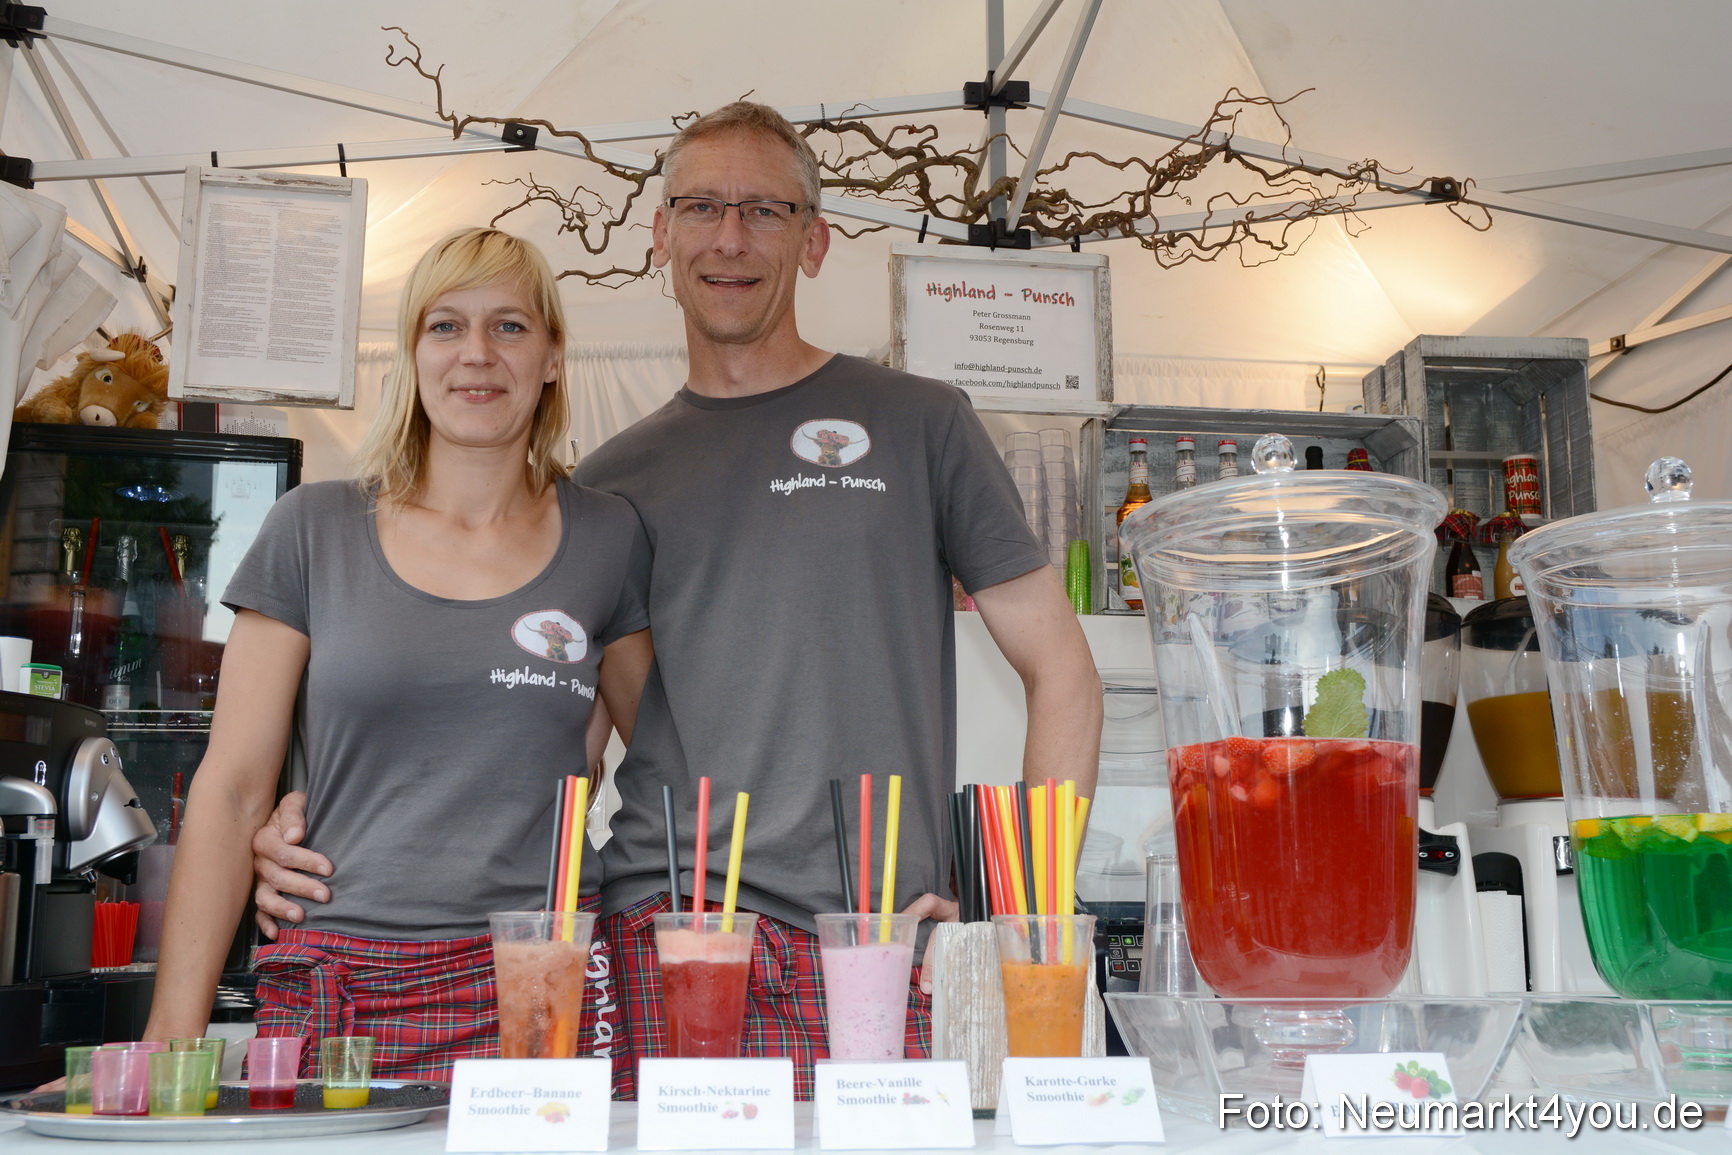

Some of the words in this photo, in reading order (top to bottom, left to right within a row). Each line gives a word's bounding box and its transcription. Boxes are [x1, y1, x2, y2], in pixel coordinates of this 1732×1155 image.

[925, 280, 996, 303] Highland
[1021, 287, 1075, 307] Punsch
[972, 310, 991, 318] Peter
[992, 311, 1031, 321] Grossmann
[979, 322, 1014, 333] Rosenweg
[1016, 325, 1025, 333] 11
[969, 334, 992, 343] 93053
[993, 336, 1034, 347] Regensburg
[954, 362, 1043, 374] info@highland-punsch.de
[943, 378, 1061, 390] w.facebook.com/highlandpunsch
[769, 472, 826, 496] Highland
[840, 475, 886, 492] Punsch
[1508, 489, 1539, 502] Punsc
[109, 658, 143, 680] umm
[489, 665, 556, 690] Highland
[836, 1077, 923, 1090] Beere-Vanille
[1024, 1075, 1118, 1088] Karotte-Gurke
[657, 1084, 771, 1098] Kirsch-Nektarine
[1026, 1090, 1086, 1103] Smoothie
[836, 1093, 897, 1106] Smoothie
[467, 1103, 531, 1116] Smoothie
[657, 1101, 719, 1113] Smoothie
